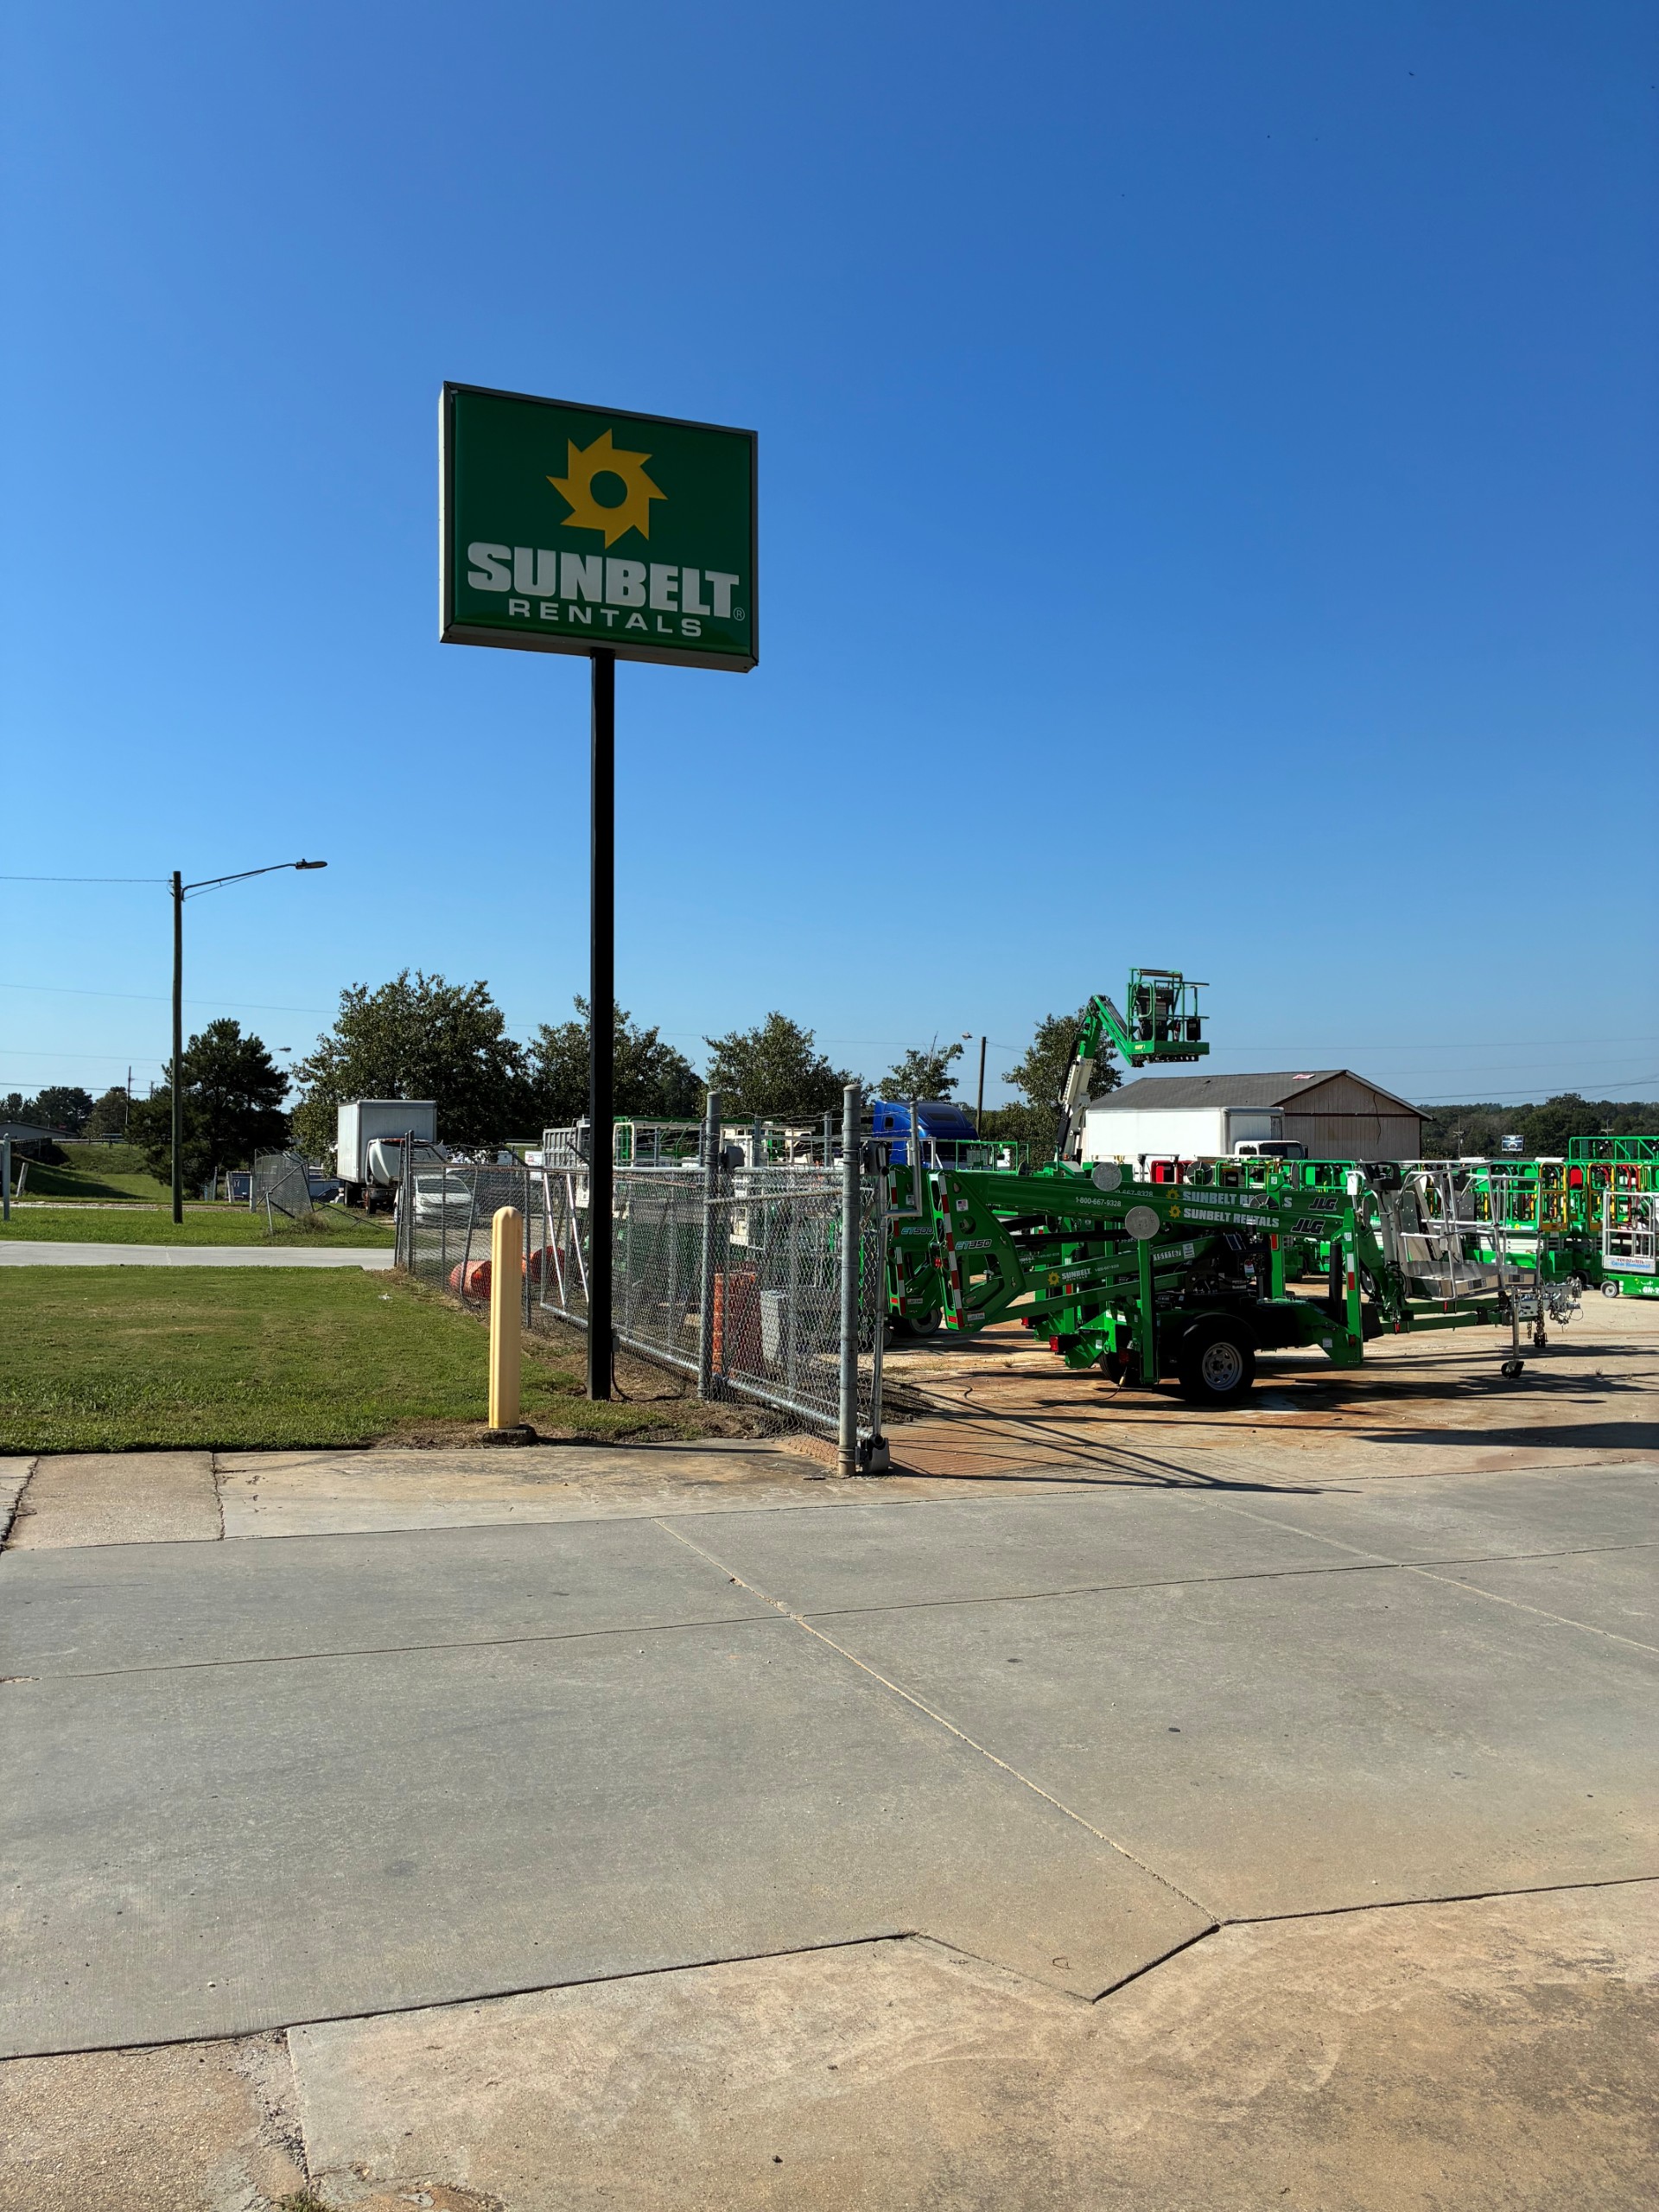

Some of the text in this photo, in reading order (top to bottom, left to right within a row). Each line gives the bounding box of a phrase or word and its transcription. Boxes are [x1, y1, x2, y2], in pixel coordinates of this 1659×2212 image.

[467, 542, 740, 619] SUNBELT
[508, 598, 702, 638] RENTALS
[1075, 1197, 1122, 1207] 1-800-667-9328
[1183, 1191, 1237, 1205] SUNBELT
[1308, 1197, 1338, 1211] JLG
[1184, 1208, 1232, 1223] SUNBELT
[1290, 1217, 1326, 1235] JLG
[955, 1239, 992, 1249] ET350
[1062, 1268, 1091, 1280] SUNBELT
